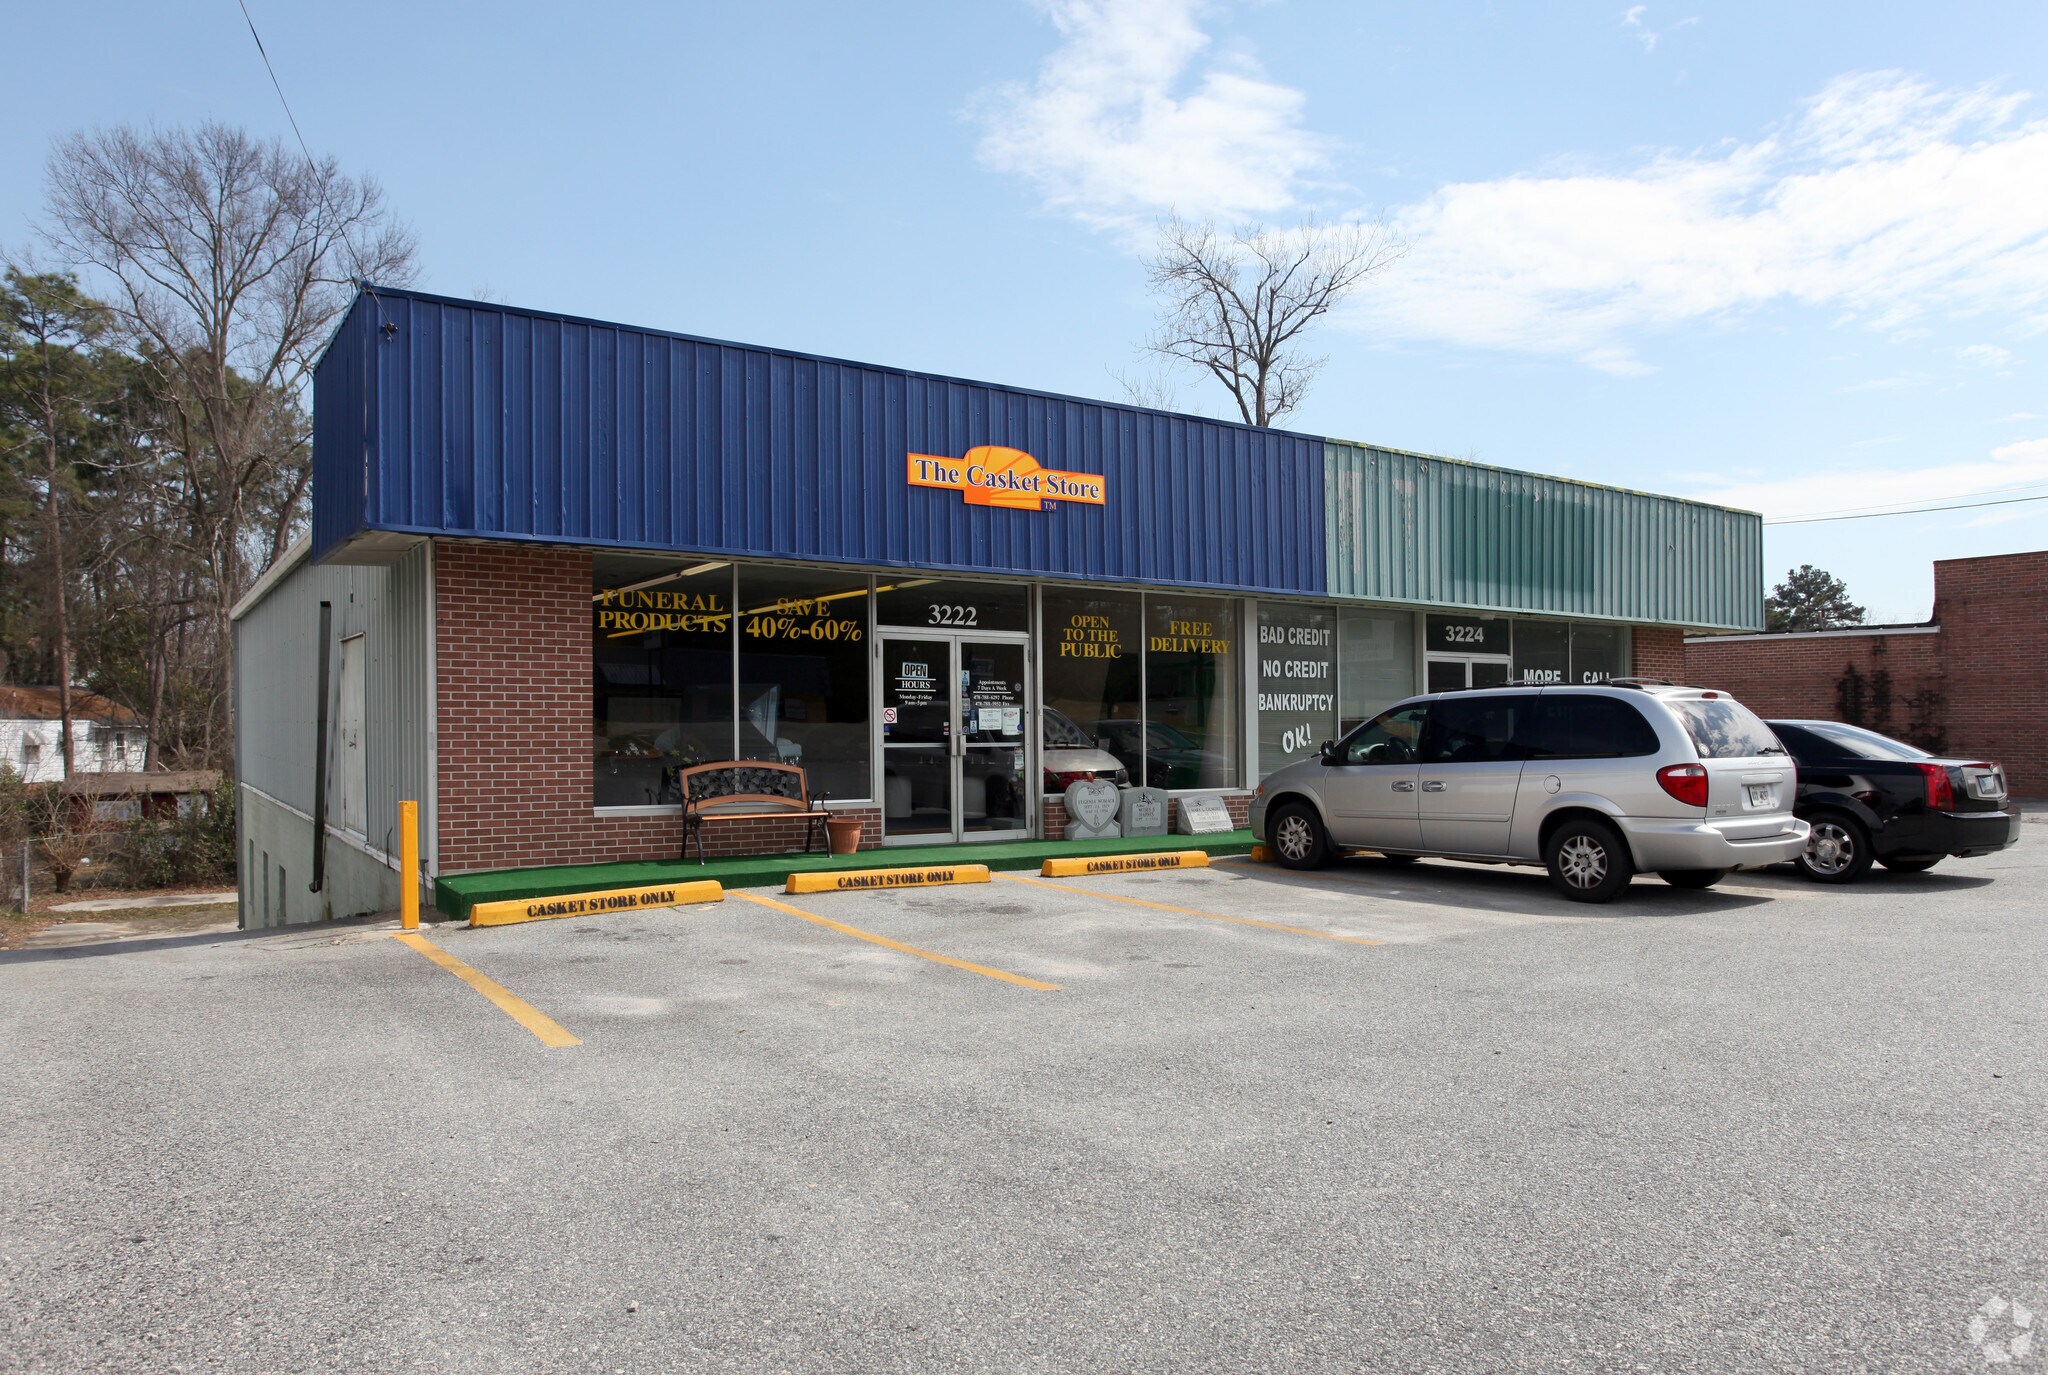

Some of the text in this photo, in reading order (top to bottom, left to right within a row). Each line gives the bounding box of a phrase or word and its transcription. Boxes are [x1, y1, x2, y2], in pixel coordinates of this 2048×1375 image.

[915, 458, 1100, 498] The Casket Store
[1044, 500, 1057, 511] TM
[602, 588, 724, 612] FUNERAL
[776, 598, 831, 618] SAVE
[598, 610, 726, 633] PRODUCTS
[928, 604, 978, 626] 3222
[1071, 614, 1109, 629] OPEN
[746, 616, 862, 642] 40%-60%
[1064, 628, 1118, 643] TO THE
[1170, 620, 1213, 637] FREE
[1260, 625, 1330, 646] BAD CREDIT
[1446, 626, 1484, 643] 3224
[1060, 642, 1122, 659] PUBLIC
[1150, 636, 1231, 654] DELIVERY
[904, 664, 927, 676] OPEN
[1262, 660, 1328, 678] NO CREDIT
[902, 680, 931, 689] HOURS
[1258, 693, 1334, 712] BANKRUPTCY
[1282, 722, 1312, 754] OK!
[1086, 856, 1181, 872] CASKET STORE ONLY
[838, 870, 955, 888] CASKET STORE ONLY
[527, 890, 676, 918] CASKET STORE ONLY
